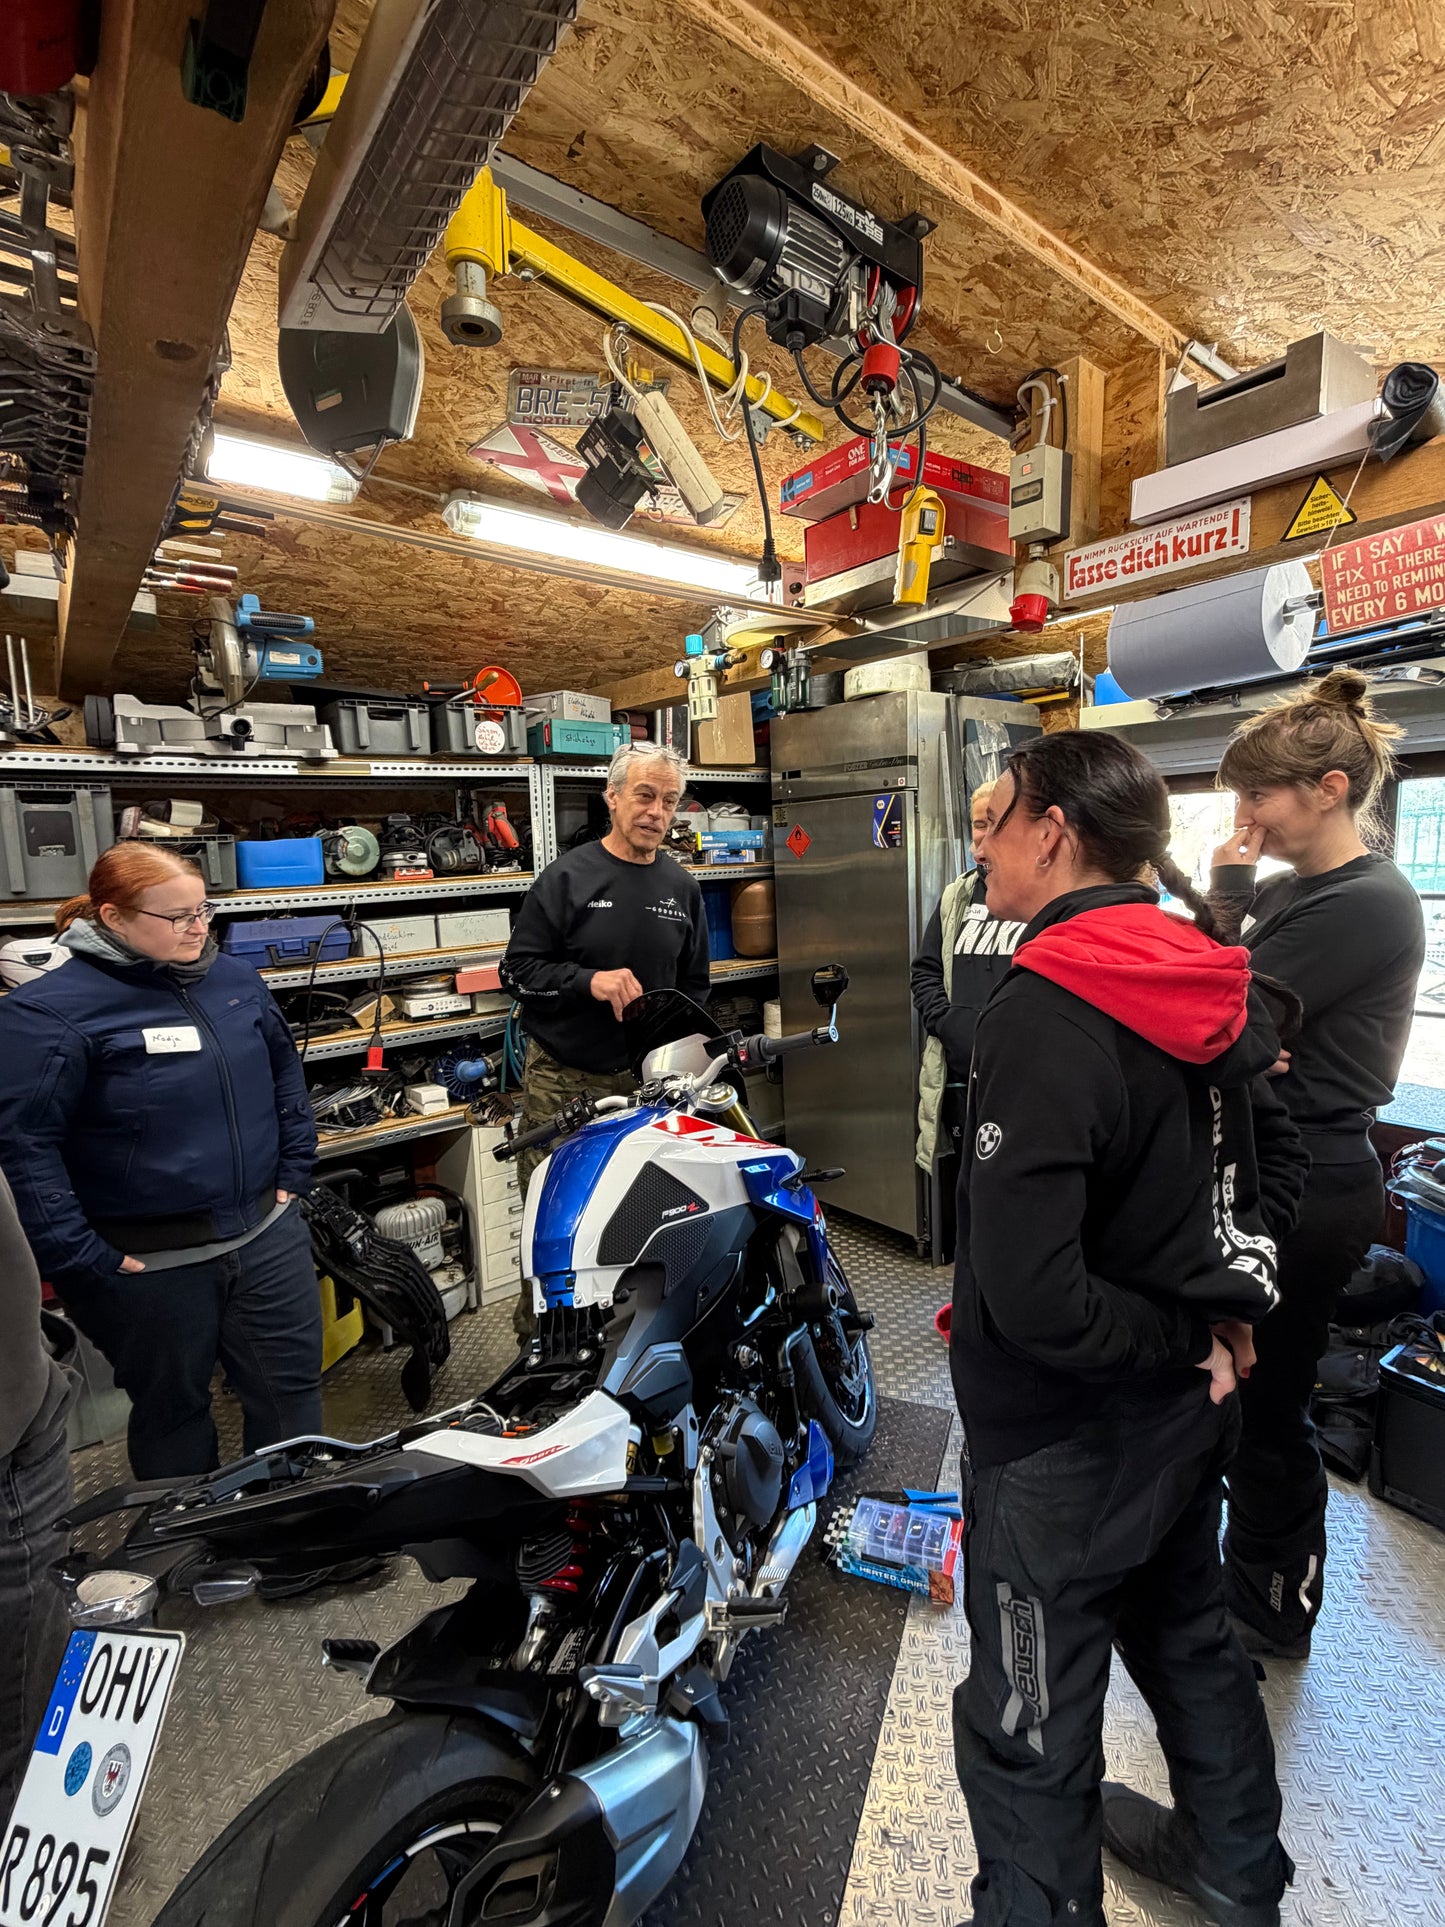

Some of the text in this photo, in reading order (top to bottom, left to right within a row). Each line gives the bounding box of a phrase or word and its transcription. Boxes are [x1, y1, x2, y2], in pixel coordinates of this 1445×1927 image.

[522, 415, 595, 425] NORTH CA
[848, 442, 866, 461] ONE
[1069, 508, 1241, 591] Fasse dich kurz!
[1084, 549, 1106, 561] NIMM
[1155, 527, 1174, 540] AUF
[1176, 511, 1230, 534] WARTENDE
[1332, 521, 1445, 571] IF I SAY I W
[1335, 566, 1366, 587] FIX
[1396, 543, 1445, 571] THERE'
[1336, 583, 1371, 605] NEED
[1392, 562, 1445, 591] REMIIN
[1331, 582, 1445, 628] EVERY 6 MO
[1209, 1085, 1222, 1146] RID
[406, 1231, 440, 1250] UN-AIR
[80, 1643, 170, 1725] OHV
[48, 1706, 64, 1737] D
[20, 1833, 111, 1927] 895
